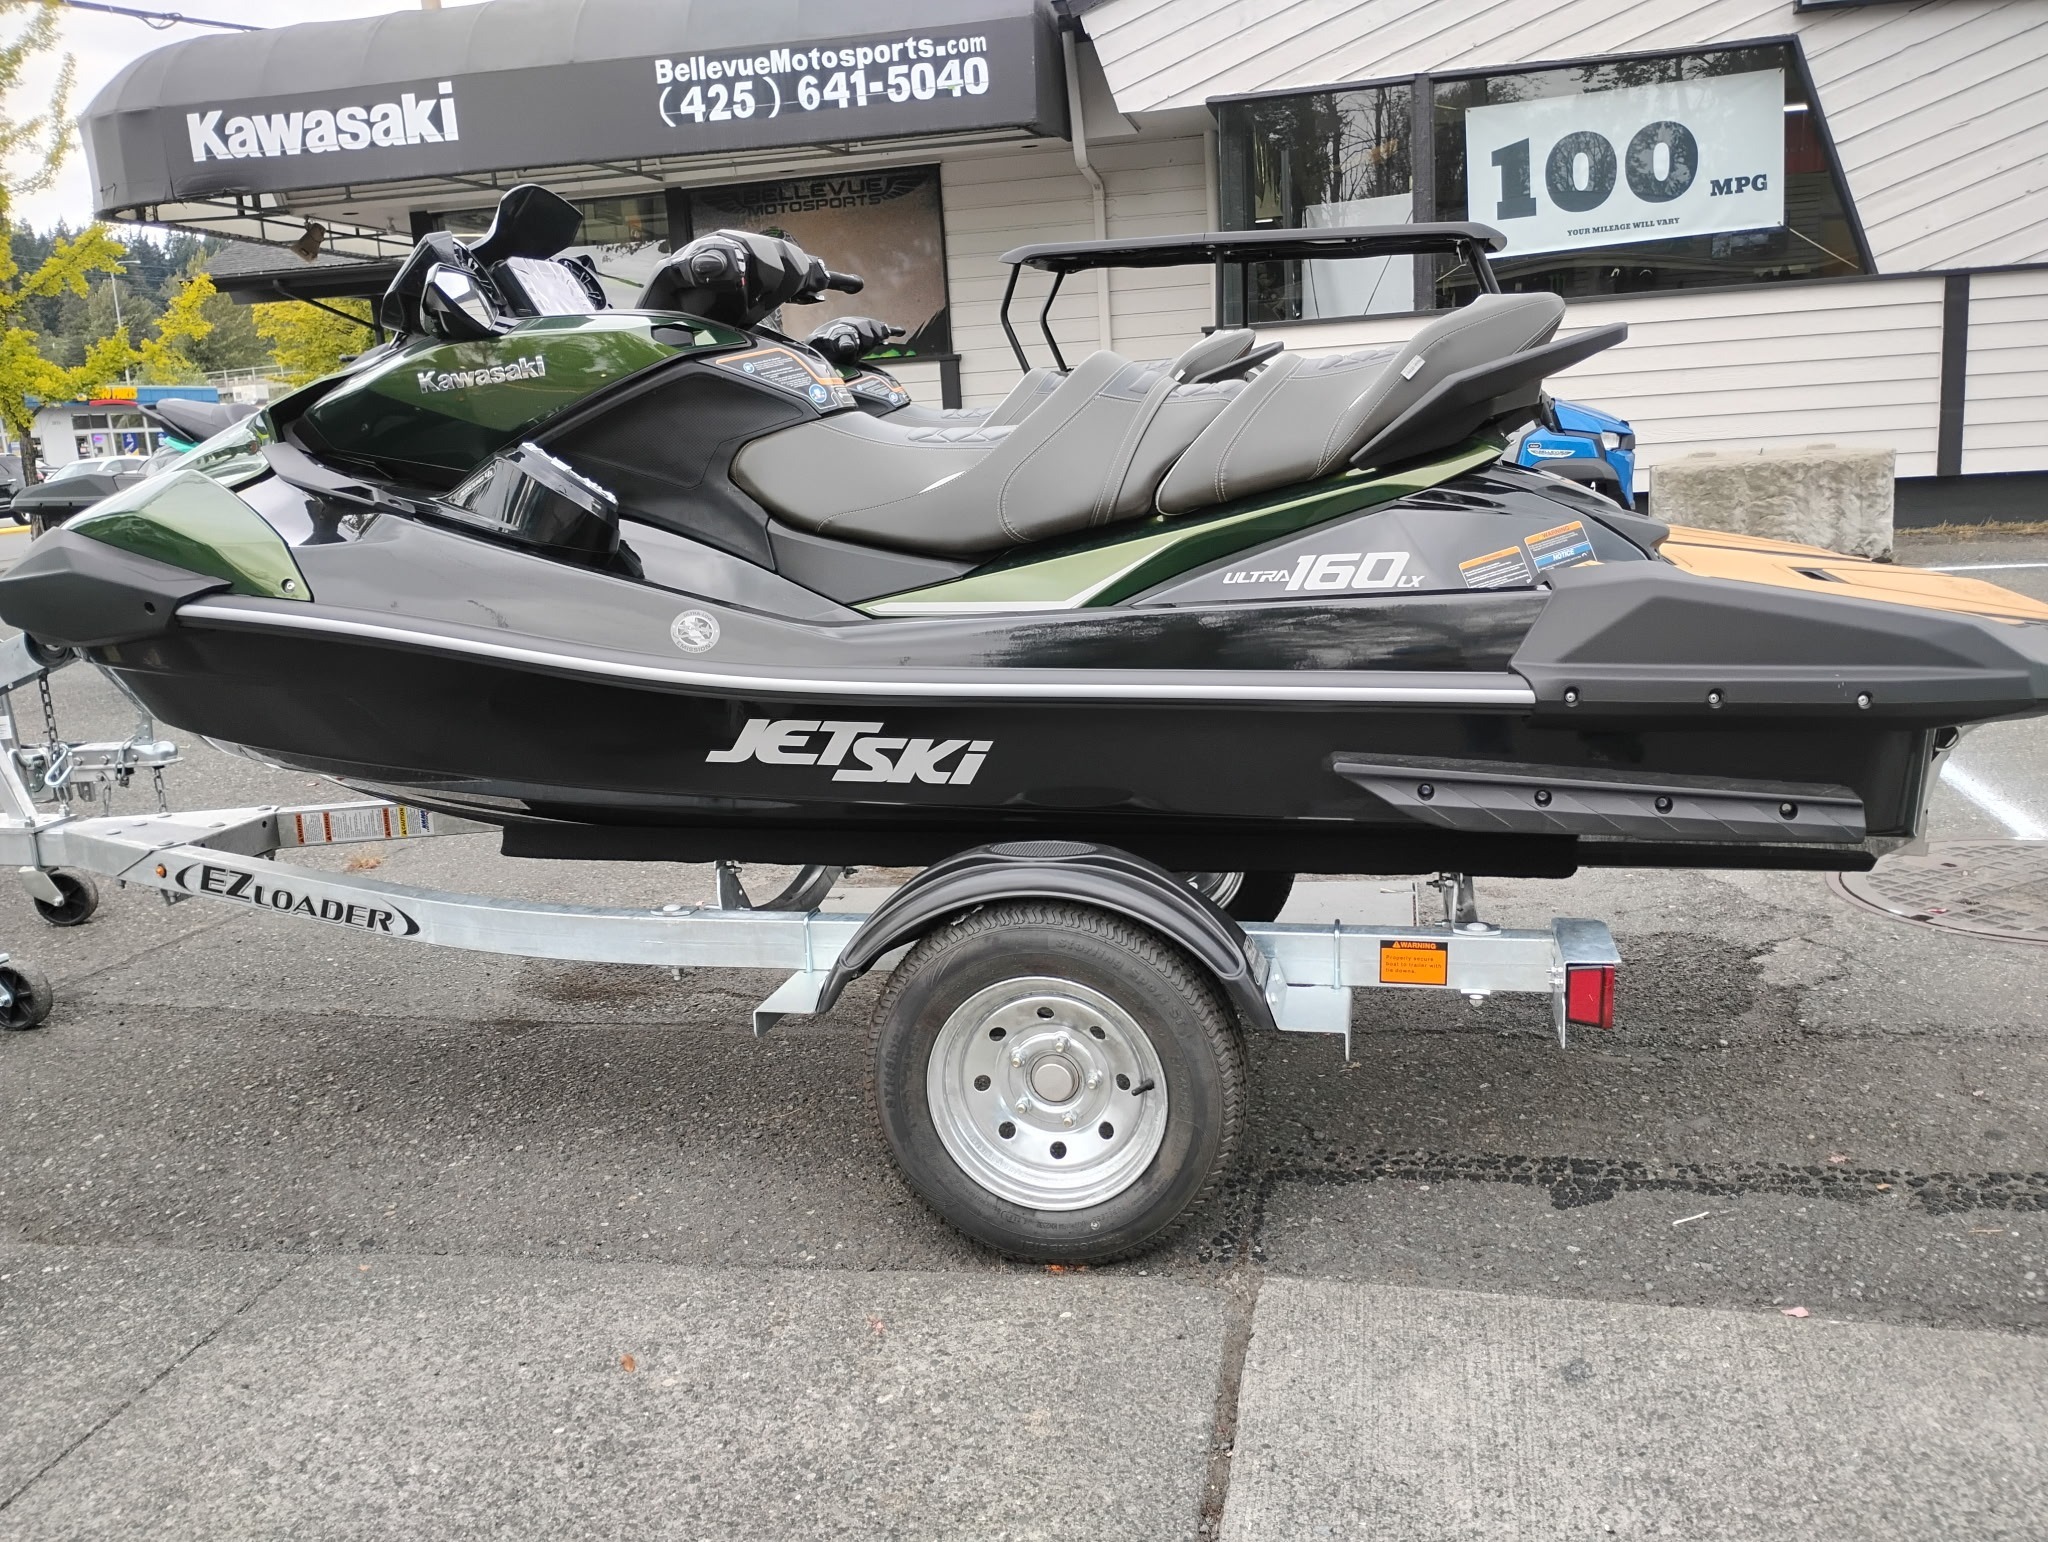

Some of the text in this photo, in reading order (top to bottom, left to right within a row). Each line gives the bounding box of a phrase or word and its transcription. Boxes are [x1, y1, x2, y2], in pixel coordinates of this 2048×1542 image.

[654, 35, 987, 84] BellevueMotosports.com
[797, 57, 989, 111] 641-5040
[186, 81, 459, 162] Kawasaki
[1491, 121, 1767, 220] 100 MPG
[743, 177, 884, 205] BELLEVUE
[750, 194, 882, 216] MOTOSPORTS
[1567, 217, 1680, 236] YOUR MILEAGE WILL VARY
[417, 355, 546, 394] Kawasaki
[1222, 551, 1426, 591] ULTRA 160 LX
[1552, 549, 1576, 561] NOTICE
[1386, 954, 1411, 962] Properly
[1400, 941, 1437, 950] WARNING
